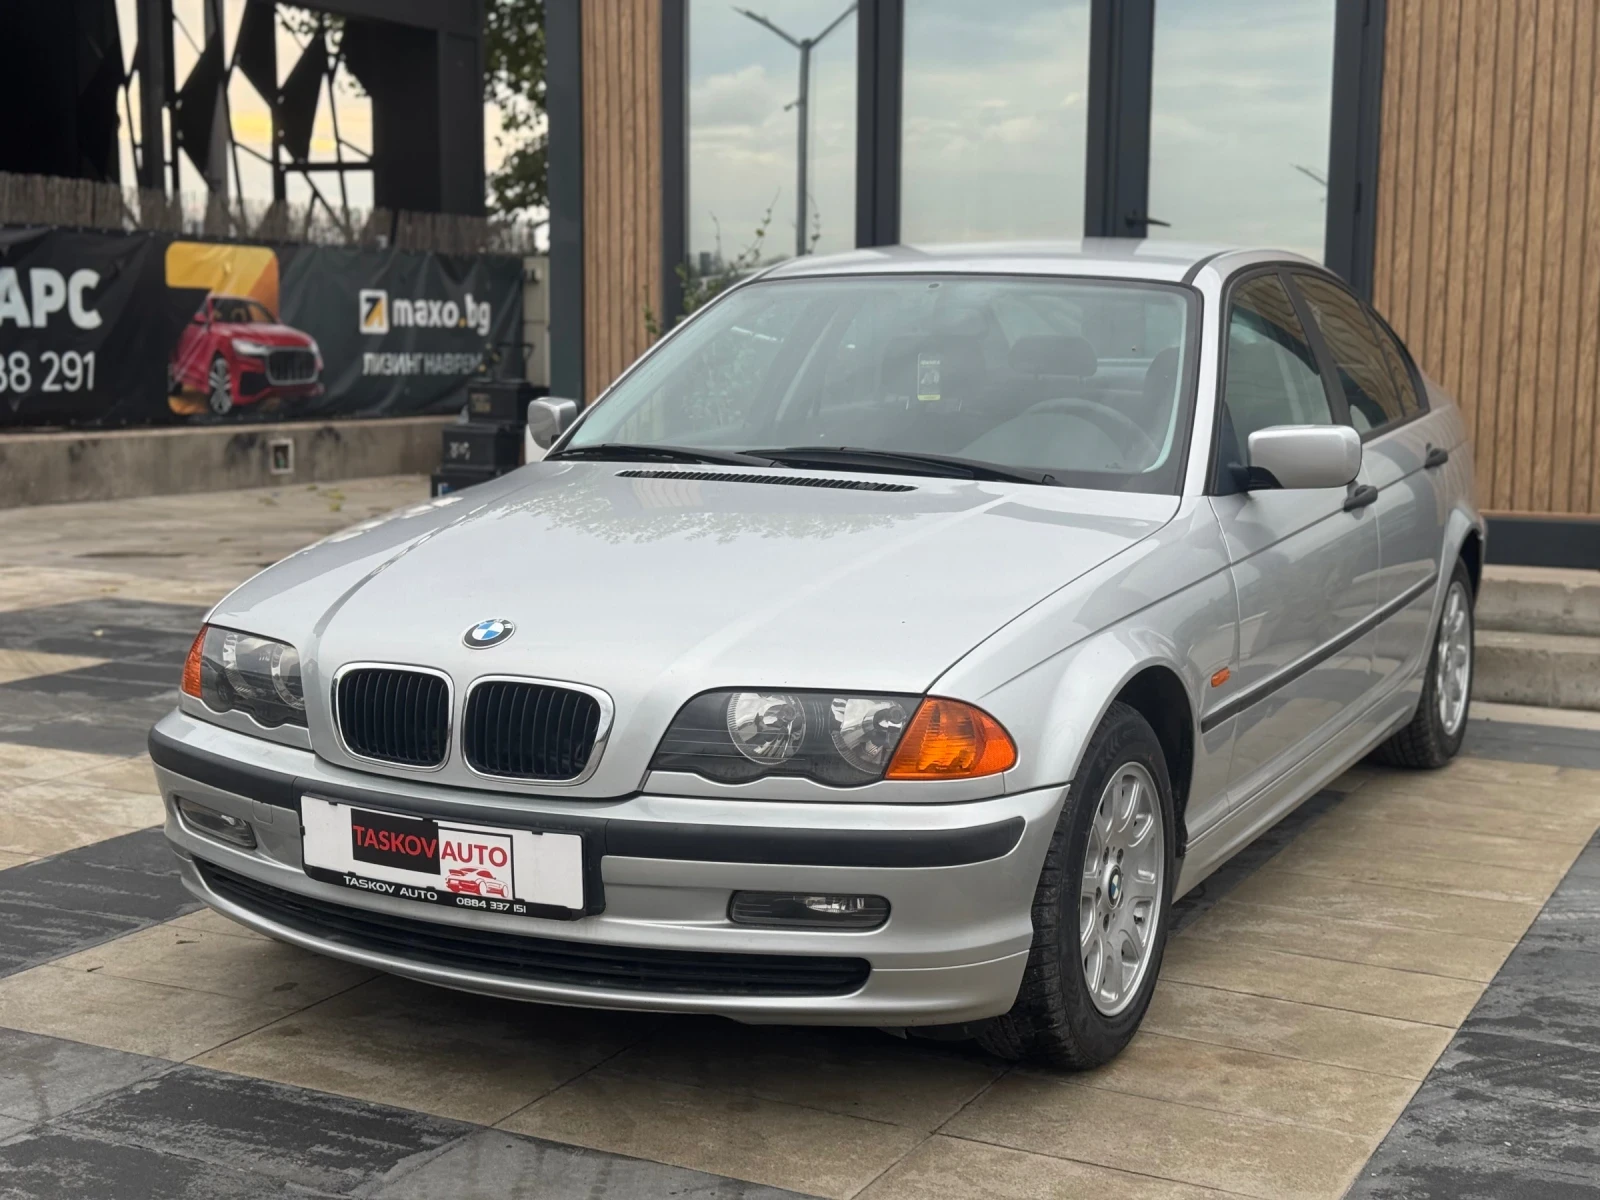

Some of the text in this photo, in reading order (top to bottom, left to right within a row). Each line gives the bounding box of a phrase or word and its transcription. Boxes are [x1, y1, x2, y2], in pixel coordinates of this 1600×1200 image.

[392, 292, 492, 337] maxo.bg
[40, 350, 96, 393] 291
[362, 352, 423, 376] ЛИЗИНГ
[353, 825, 508, 868] TASKOV AUTO
[343, 875, 527, 914] TASKOV AUTO 0884 337 151
